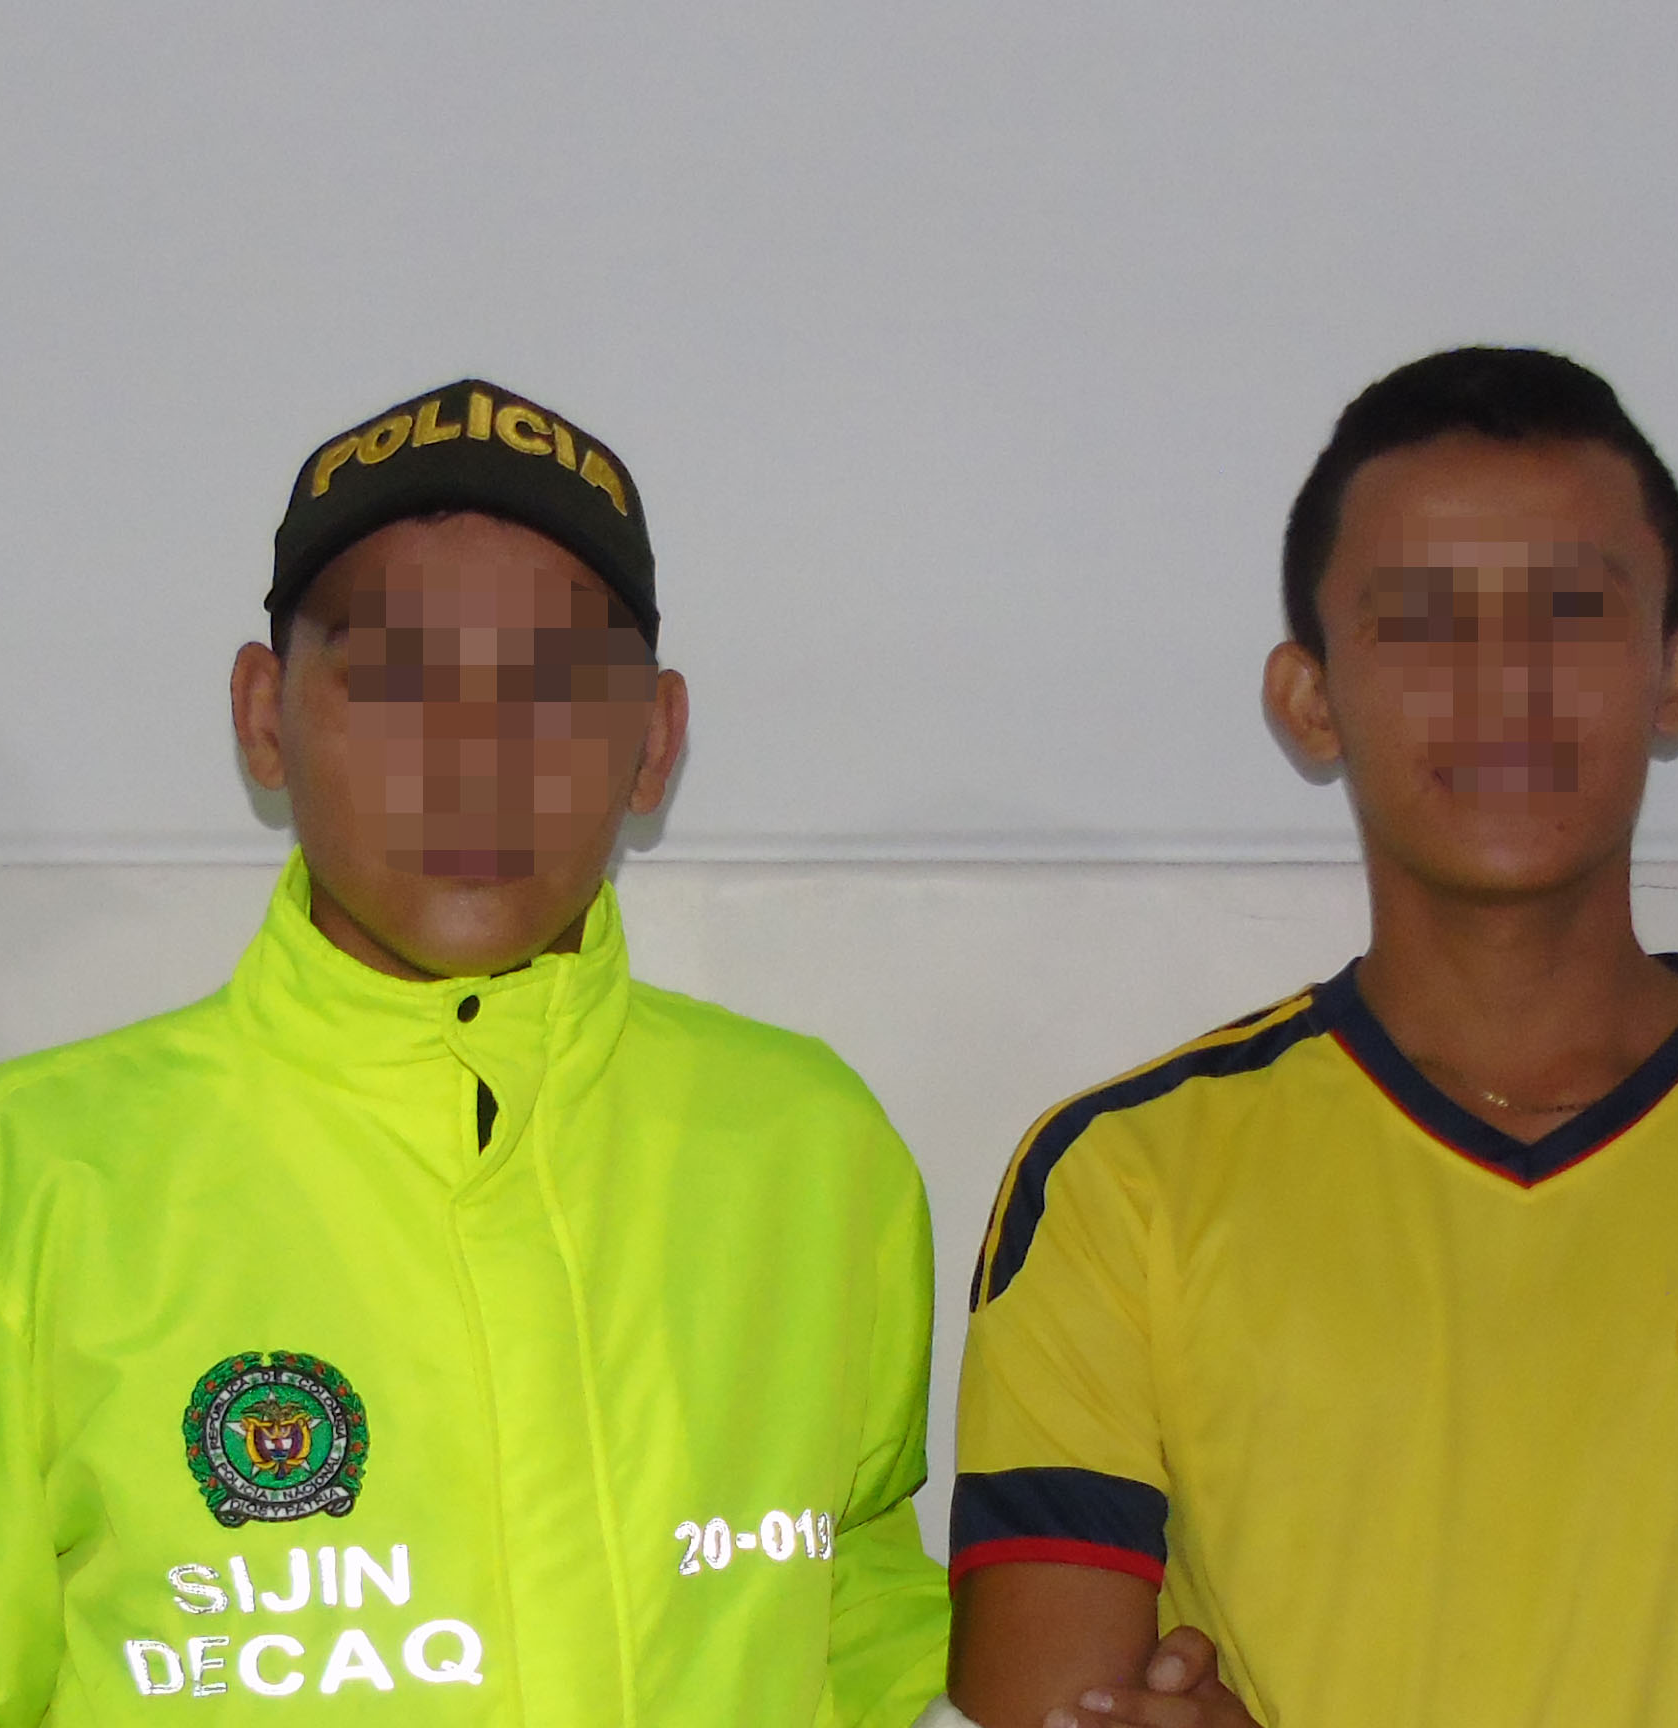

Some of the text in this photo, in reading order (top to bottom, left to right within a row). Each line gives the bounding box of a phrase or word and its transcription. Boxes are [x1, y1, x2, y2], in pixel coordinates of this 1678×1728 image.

[311, 392, 627, 516] POLICIA
[216, 1454, 341, 1501] POLICIA NACIONAL
[229, 1487, 340, 1517] DIOS Y PATRIA
[168, 1543, 412, 1615] SIJIN
[126, 1618, 484, 1698] DECAQ
